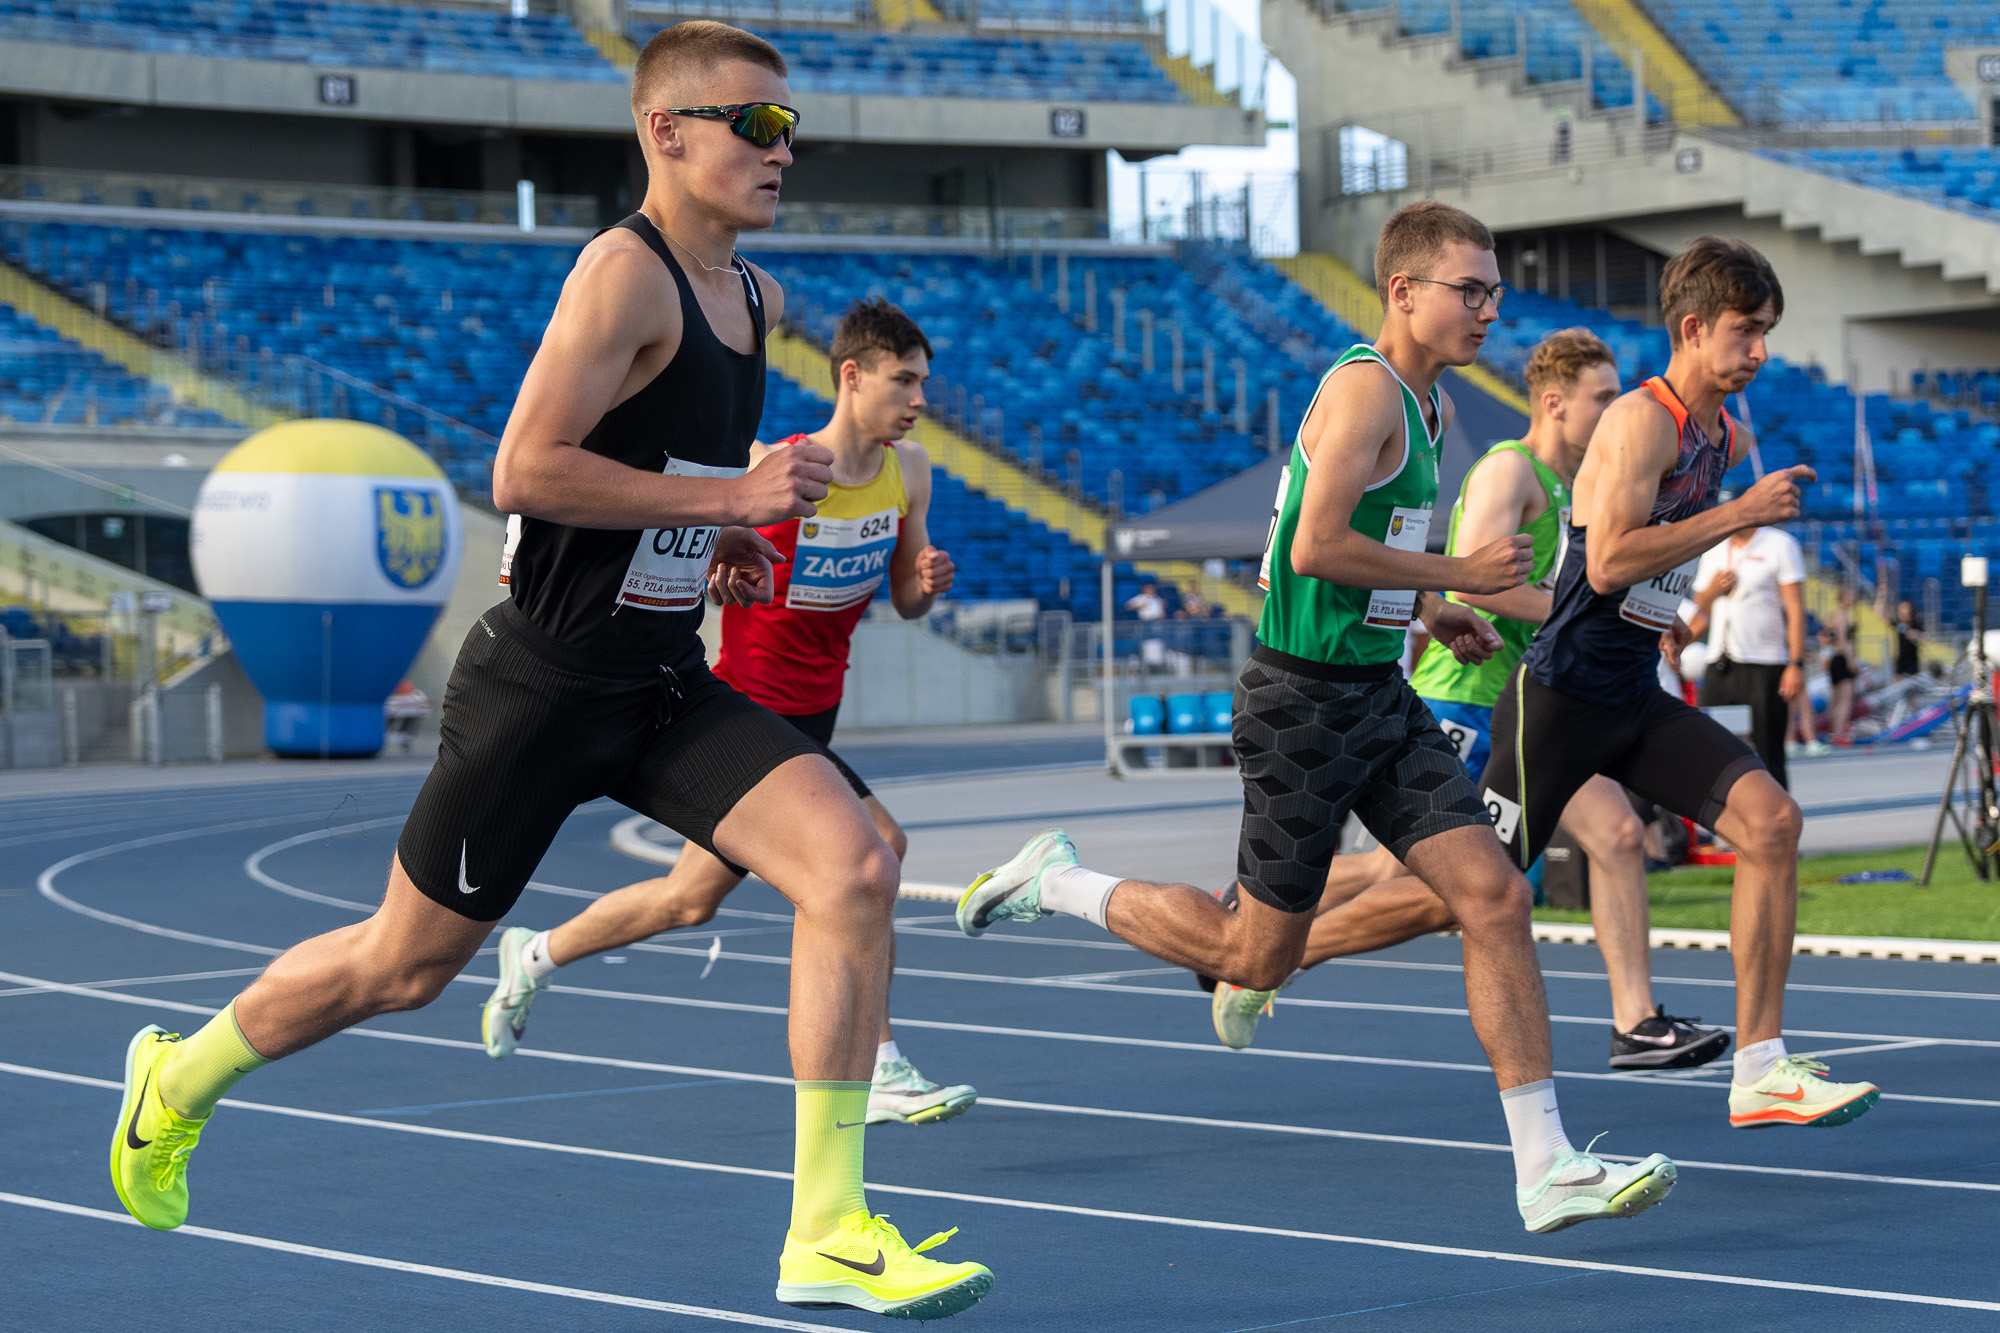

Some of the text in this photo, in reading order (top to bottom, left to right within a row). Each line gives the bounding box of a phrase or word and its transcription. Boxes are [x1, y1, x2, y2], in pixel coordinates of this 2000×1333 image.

[860, 514, 890, 538] 624
[802, 548, 888, 578] ZACZYK
[626, 578, 640, 590] 55.
[643, 582, 663, 594] PZLA
[1448, 728, 1465, 754] 8
